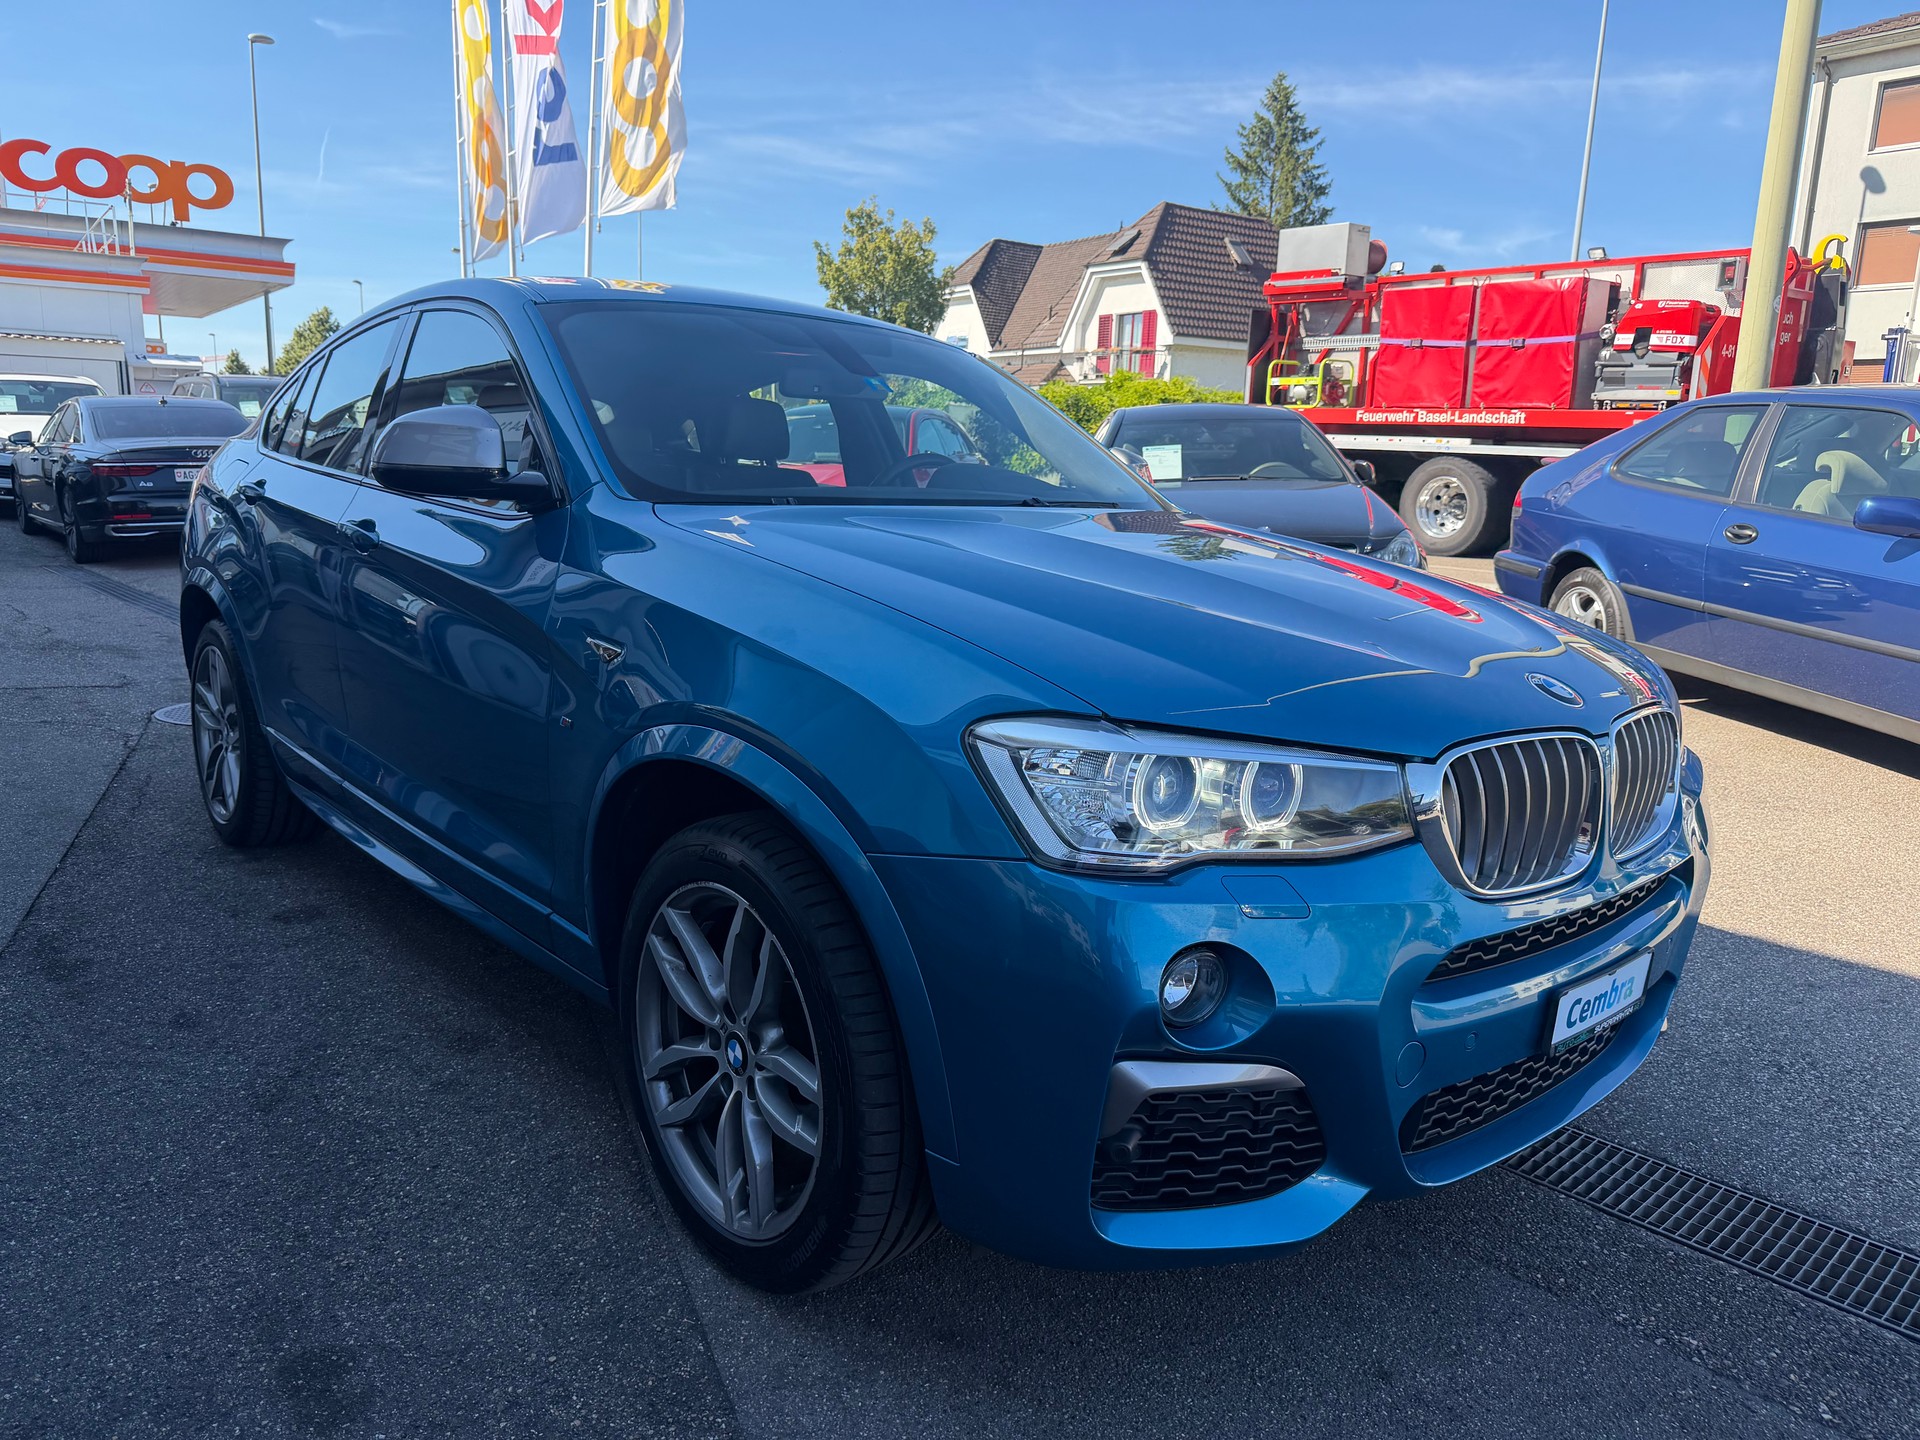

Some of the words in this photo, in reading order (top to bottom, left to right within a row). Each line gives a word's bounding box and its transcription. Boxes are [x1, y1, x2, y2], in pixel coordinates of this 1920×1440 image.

[0, 138, 234, 222] coop
[1665, 335, 1685, 344] FOX
[1356, 410, 1415, 422] Feuerwehr
[1417, 410, 1526, 424] Basel-Landschaft
[1566, 976, 1635, 1029] Cembra
